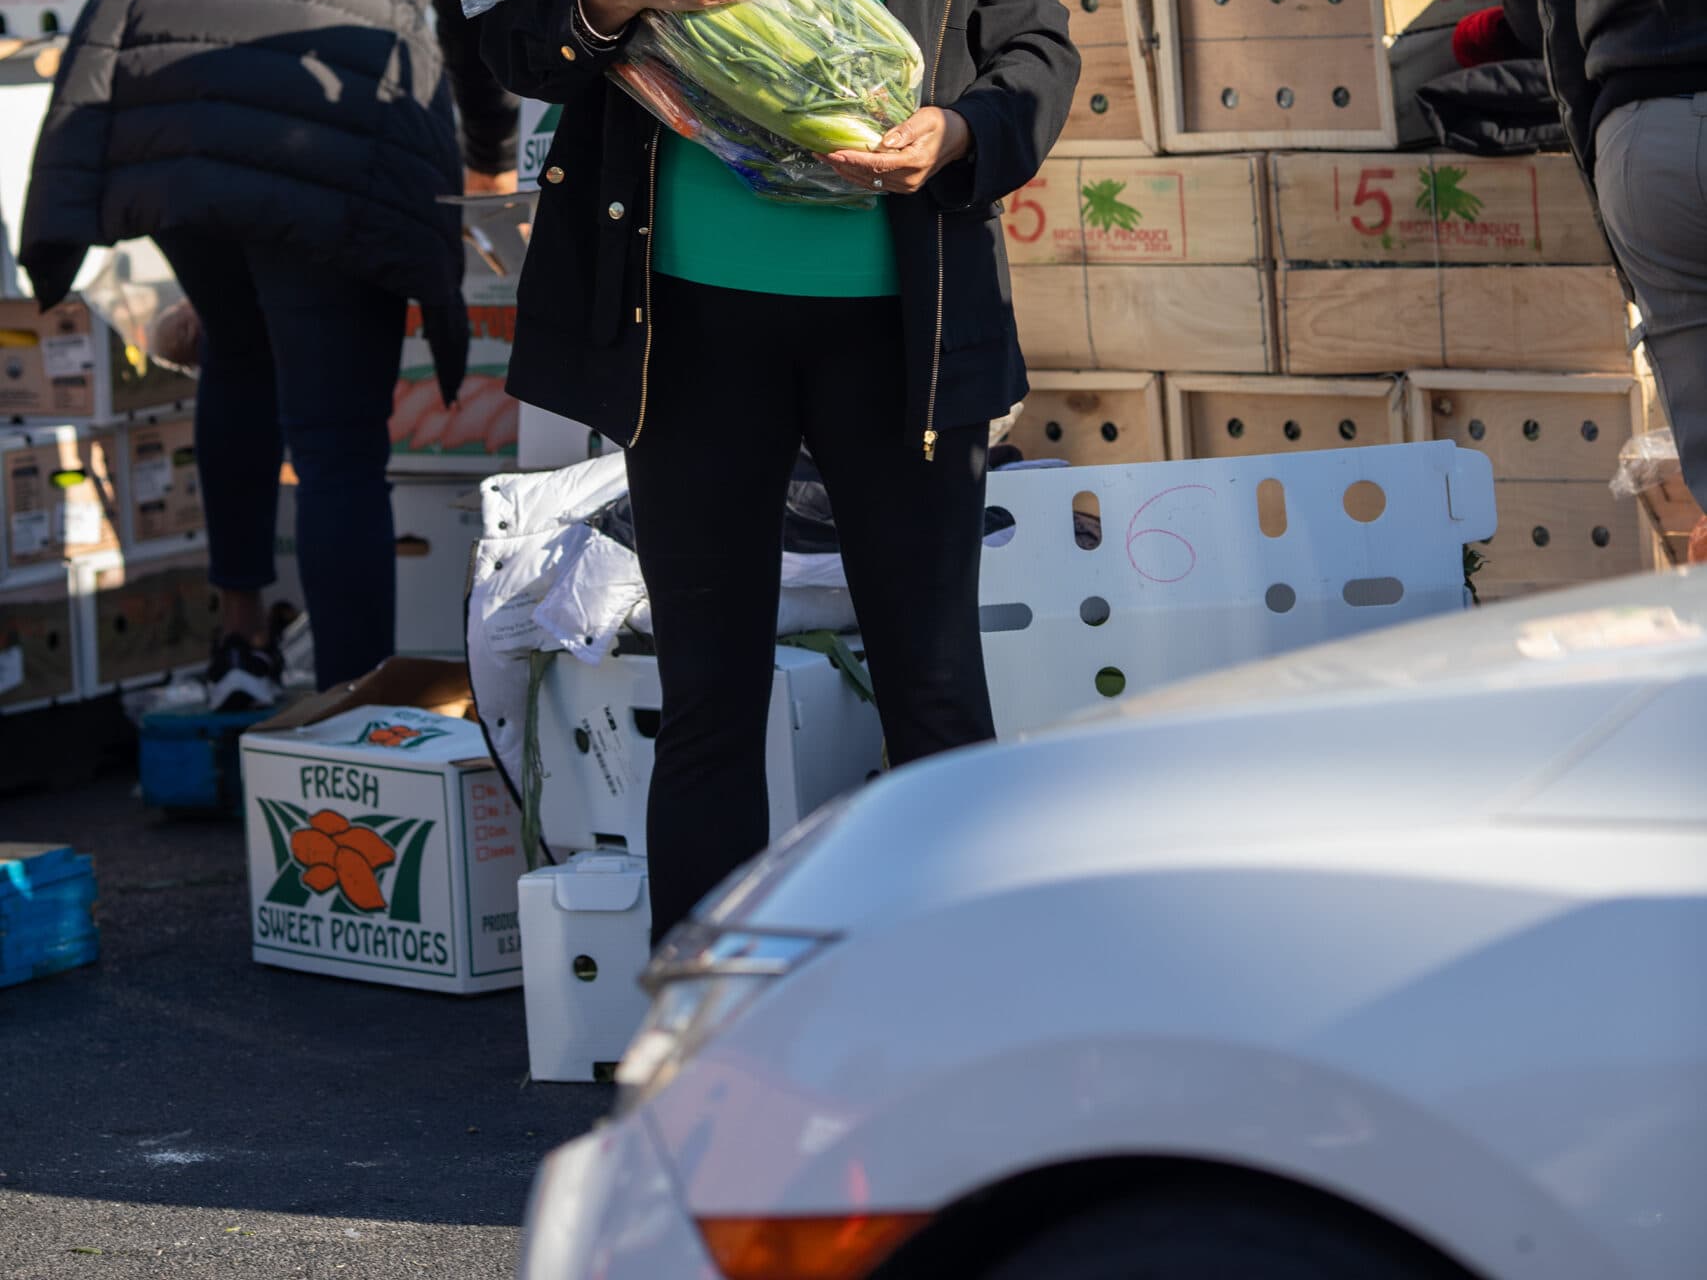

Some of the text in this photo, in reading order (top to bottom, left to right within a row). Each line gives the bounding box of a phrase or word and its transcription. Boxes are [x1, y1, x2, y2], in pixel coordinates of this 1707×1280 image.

[1008, 177, 1047, 244] 5
[1351, 168, 1394, 236] 5
[1127, 484, 1216, 583] 6
[301, 765, 380, 809] FRESH
[258, 905, 449, 966] SWEET POTATOES
